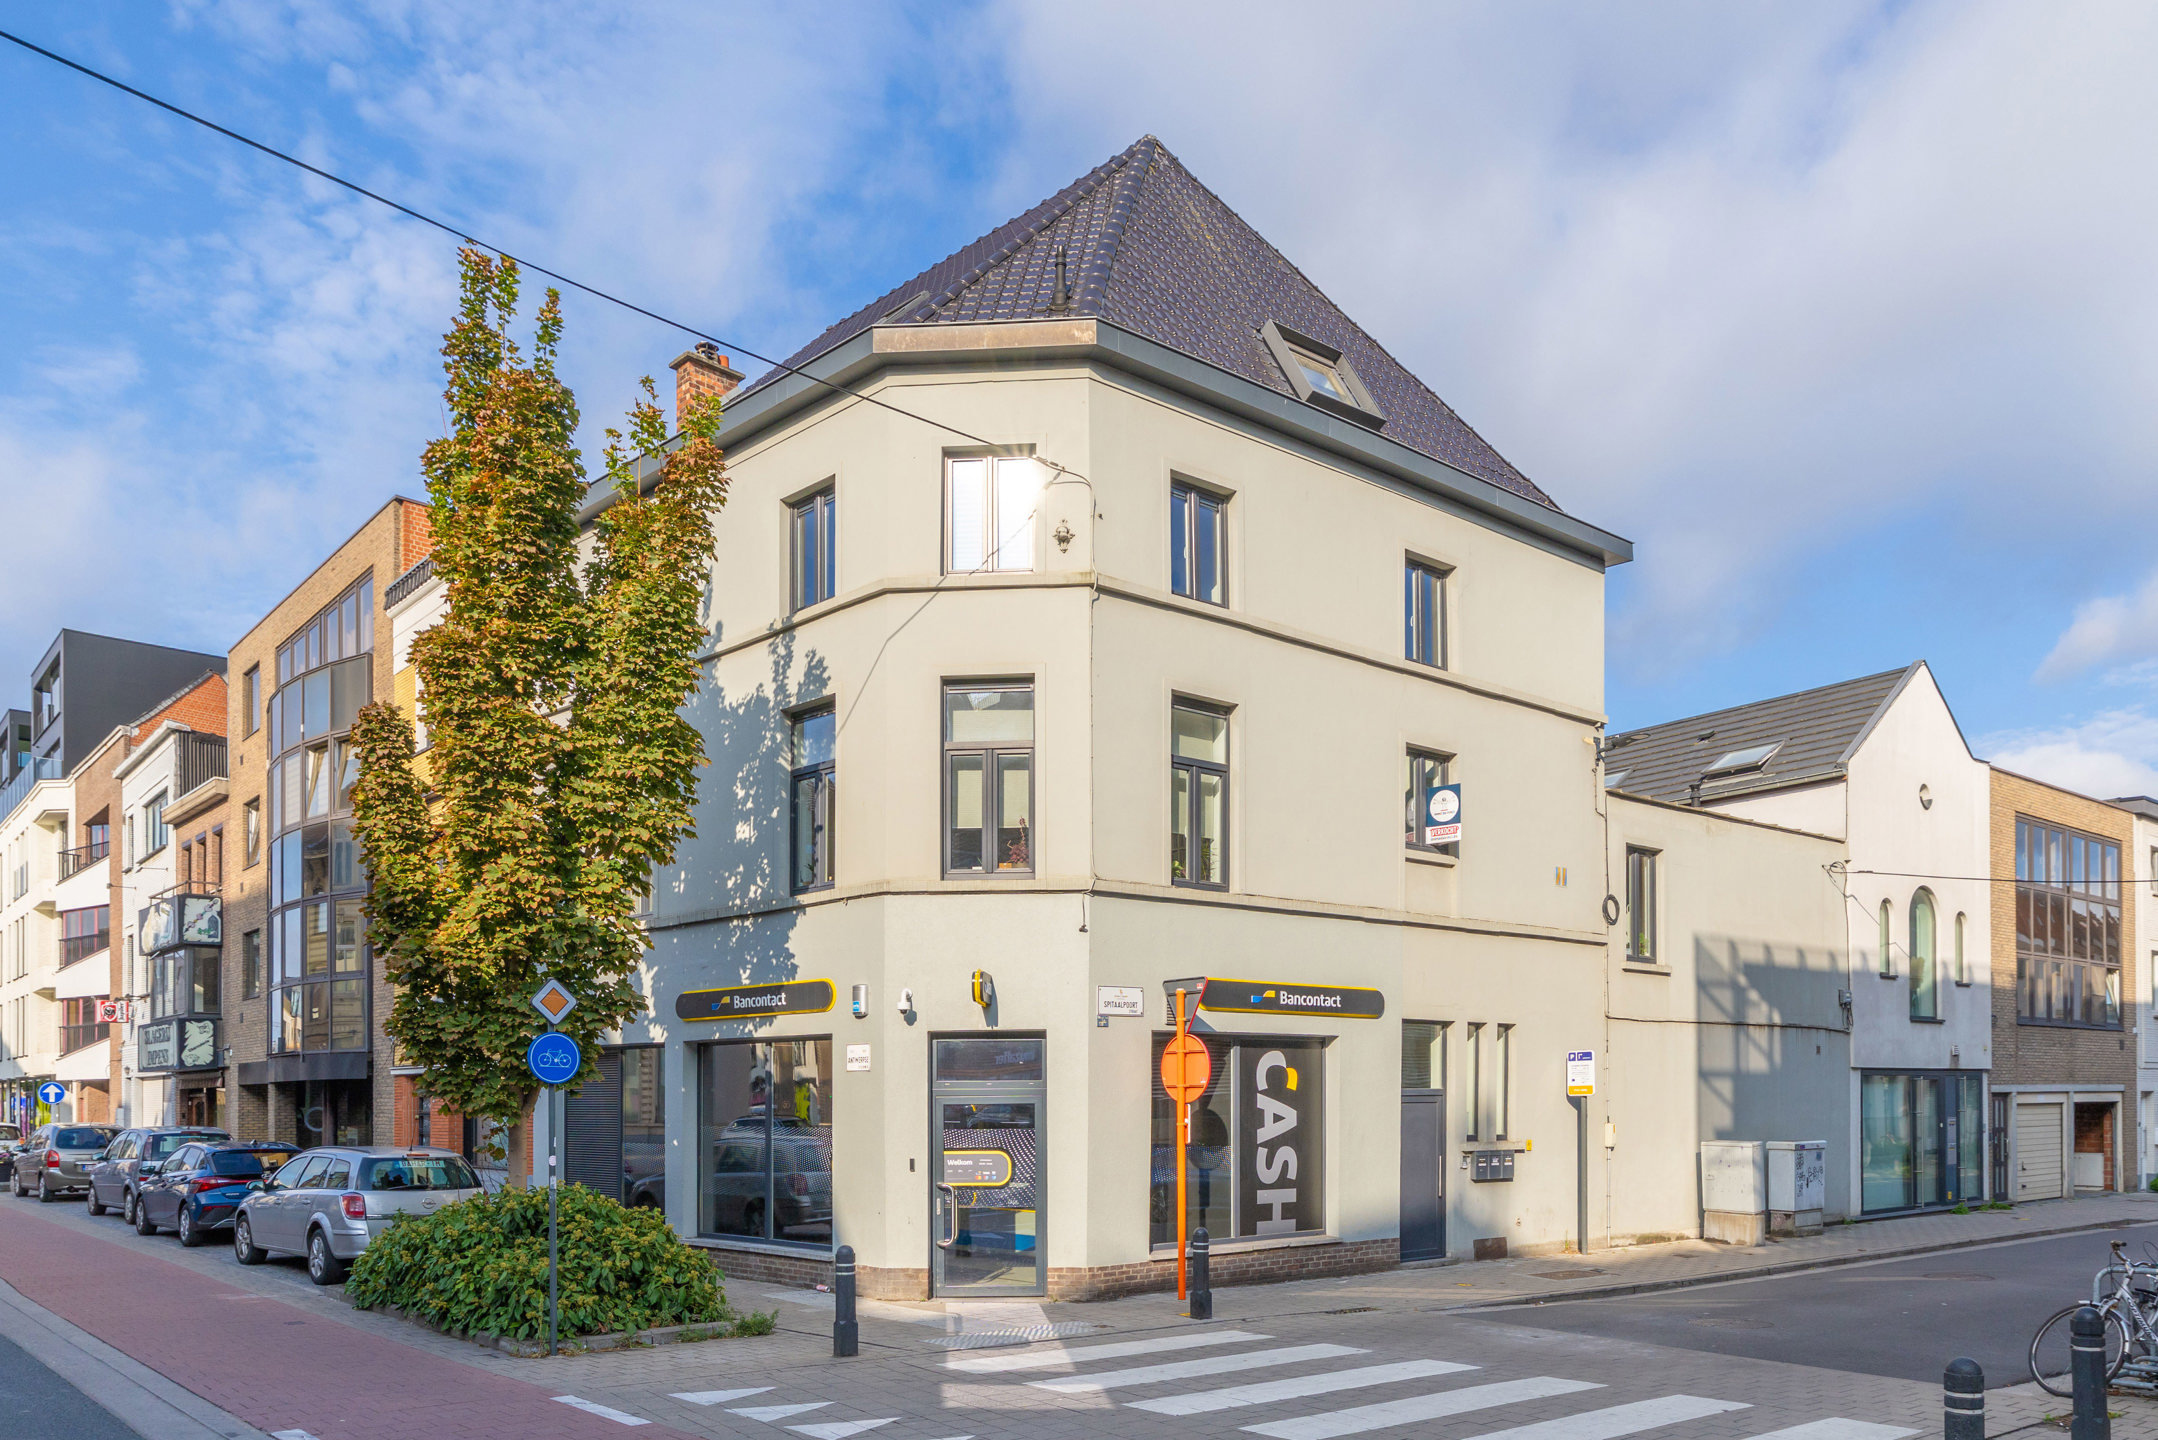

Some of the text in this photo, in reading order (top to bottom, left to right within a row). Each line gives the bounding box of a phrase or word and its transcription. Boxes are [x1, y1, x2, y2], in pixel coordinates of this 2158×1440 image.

[733, 992, 787, 1009] Bancontact
[1279, 990, 1342, 1008] Bancontact
[1256, 1050, 1298, 1236] CASH
